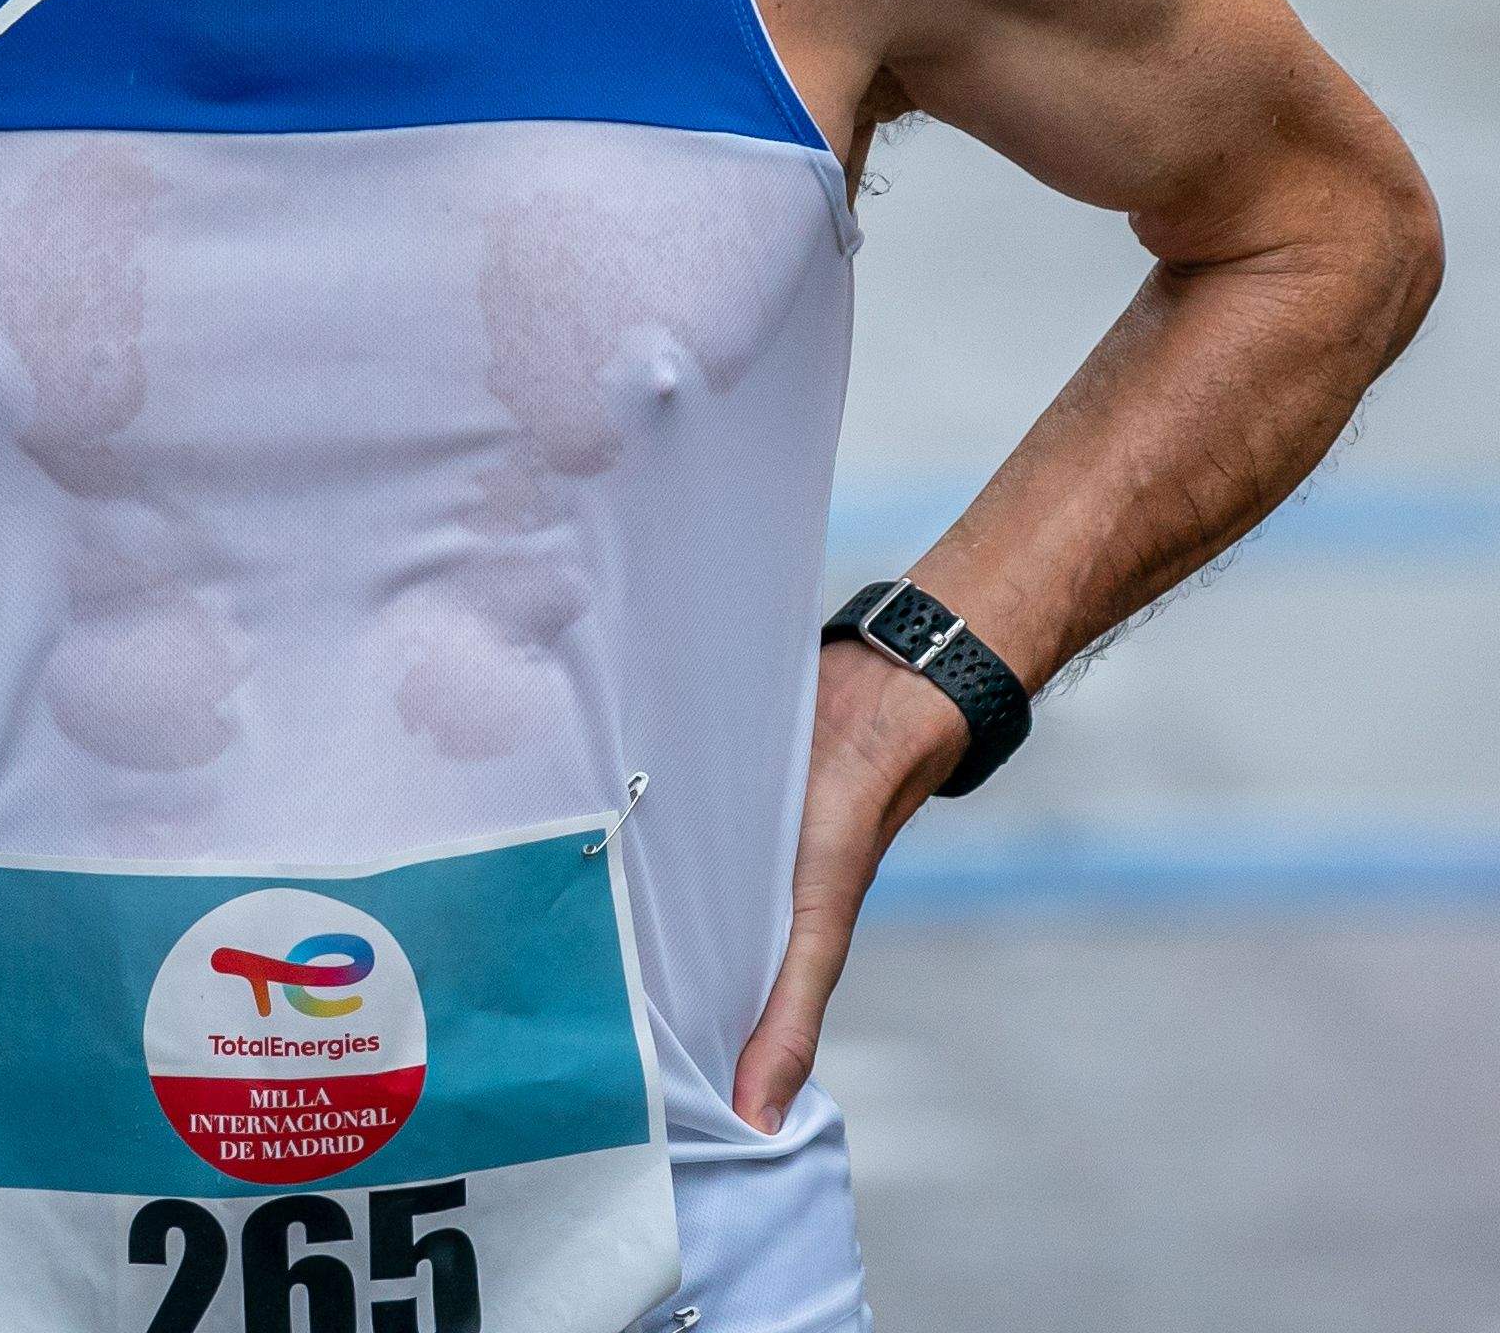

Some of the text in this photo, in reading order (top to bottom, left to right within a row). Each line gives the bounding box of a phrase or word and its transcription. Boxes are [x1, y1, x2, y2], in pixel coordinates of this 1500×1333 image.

[208, 1033, 380, 1060] TotalEnergies
[250, 1087, 332, 1109] MILLA
[220, 1134, 365, 1160] DE MADRID
[128, 1178, 482, 1333] 265
